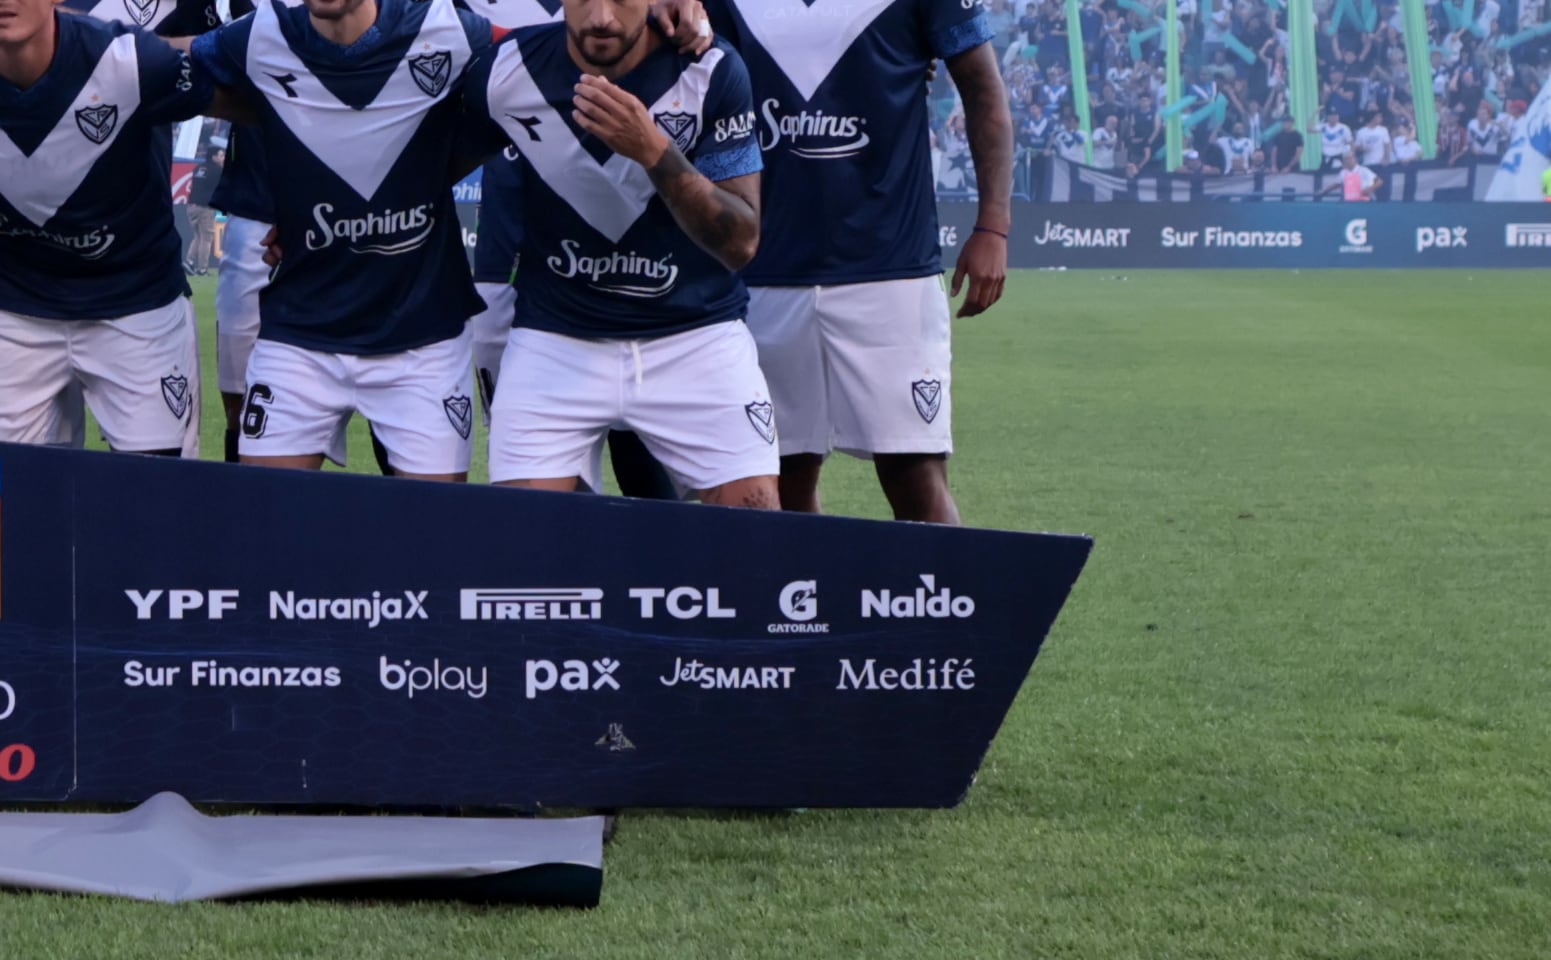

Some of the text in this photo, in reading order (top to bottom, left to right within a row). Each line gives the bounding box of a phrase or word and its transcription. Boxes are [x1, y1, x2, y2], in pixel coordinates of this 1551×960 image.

[759, 98, 860, 151] Saphirus
[306, 203, 428, 251] Saphirus
[1035, 220, 1130, 247] JetSMART
[1161, 226, 1302, 248] Sur Finanzas
[1416, 225, 1467, 252] pax
[547, 239, 670, 282] Saphirus
[243, 383, 274, 439] 6
[125, 590, 239, 619] YPF
[269, 590, 429, 628] NaranjaX
[460, 588, 604, 620] PIRELLI
[629, 587, 736, 619] TCL
[861, 574, 975, 618] Naldo
[767, 623, 829, 633] GATORADE
[124, 660, 341, 687] Sur Finanzas
[379, 655, 487, 699] bplay
[525, 657, 620, 699] pax
[660, 657, 796, 689] JetSMART
[836, 658, 975, 690] Medifé
